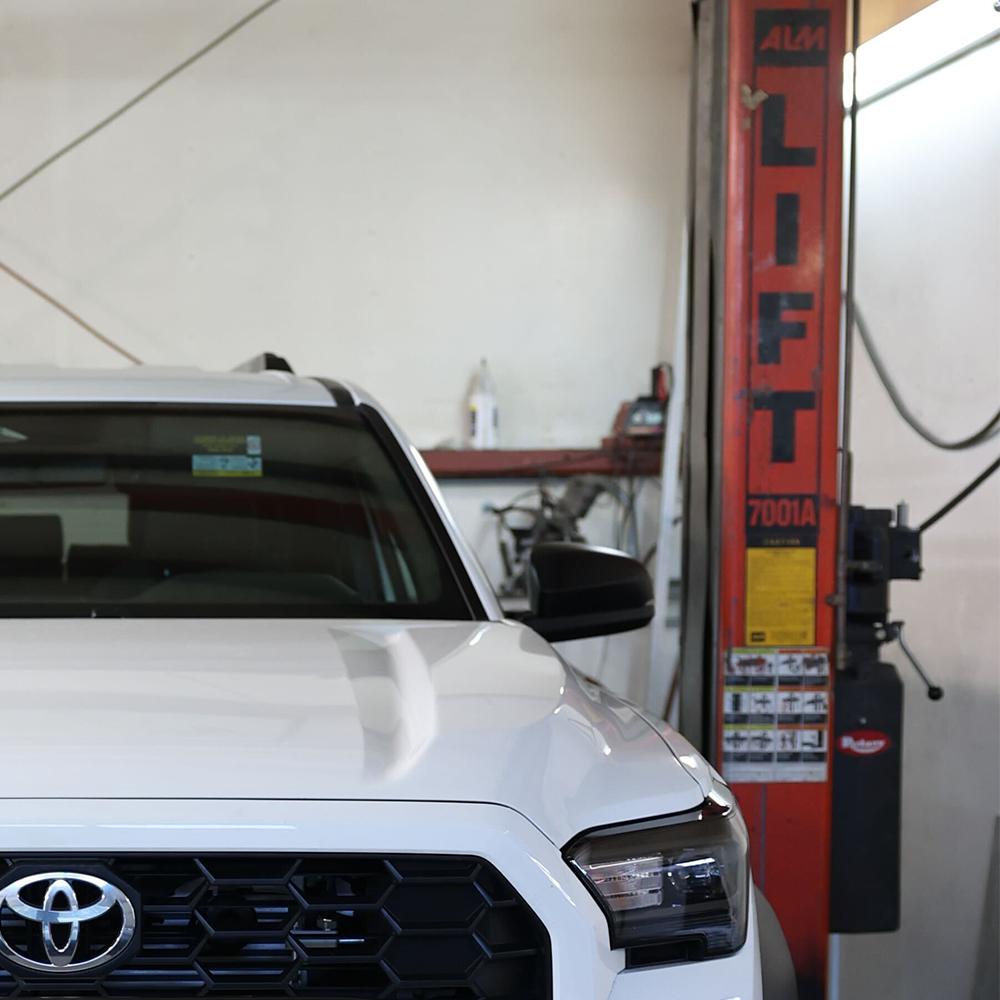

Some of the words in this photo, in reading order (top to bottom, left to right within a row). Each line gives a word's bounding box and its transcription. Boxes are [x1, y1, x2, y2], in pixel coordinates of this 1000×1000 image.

[760, 25, 826, 50] ALM
[754, 94, 816, 463] LIFT
[748, 498, 817, 527] 7001A
